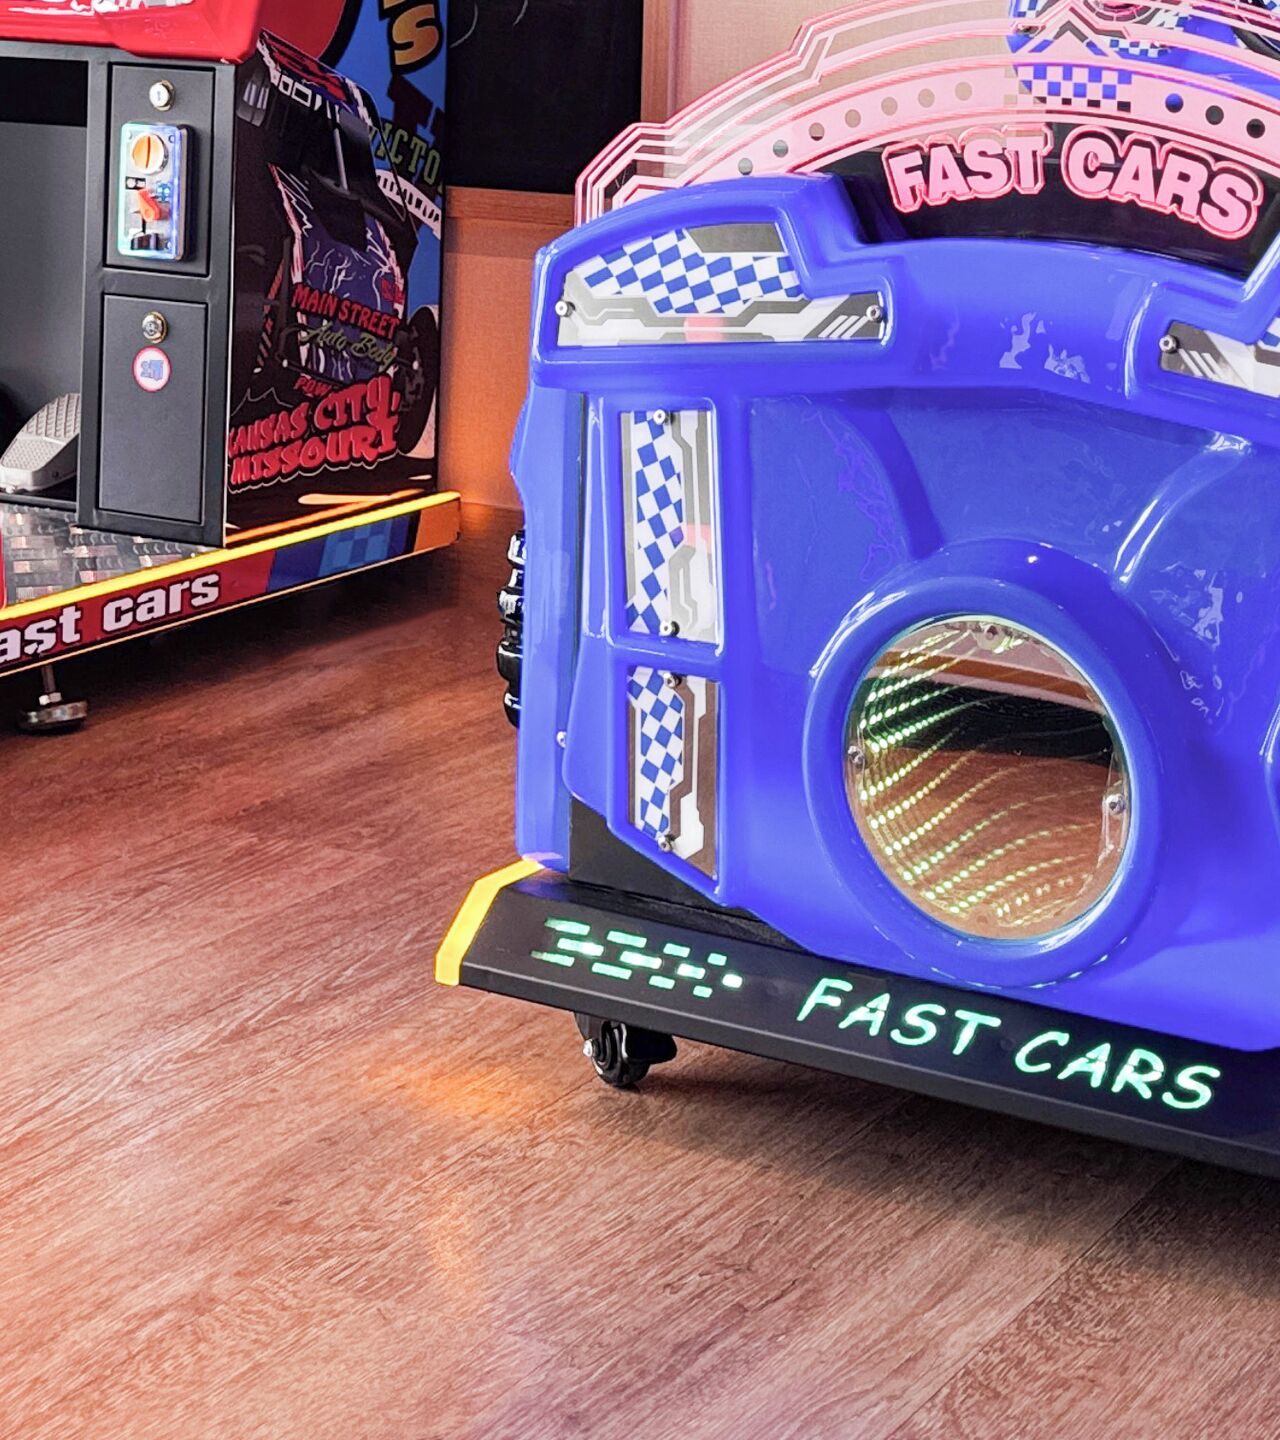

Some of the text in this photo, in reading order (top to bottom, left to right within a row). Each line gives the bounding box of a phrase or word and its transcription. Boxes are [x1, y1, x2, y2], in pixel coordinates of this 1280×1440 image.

[885, 127, 1263, 238] FAST CARS
[291, 284, 400, 339] MAIN STREET
[300, 321, 398, 372] Auto Body
[231, 417, 398, 485] MISSOURI
[103, 573, 219, 632] cars
[796, 977, 1220, 1110] FAST CARS
